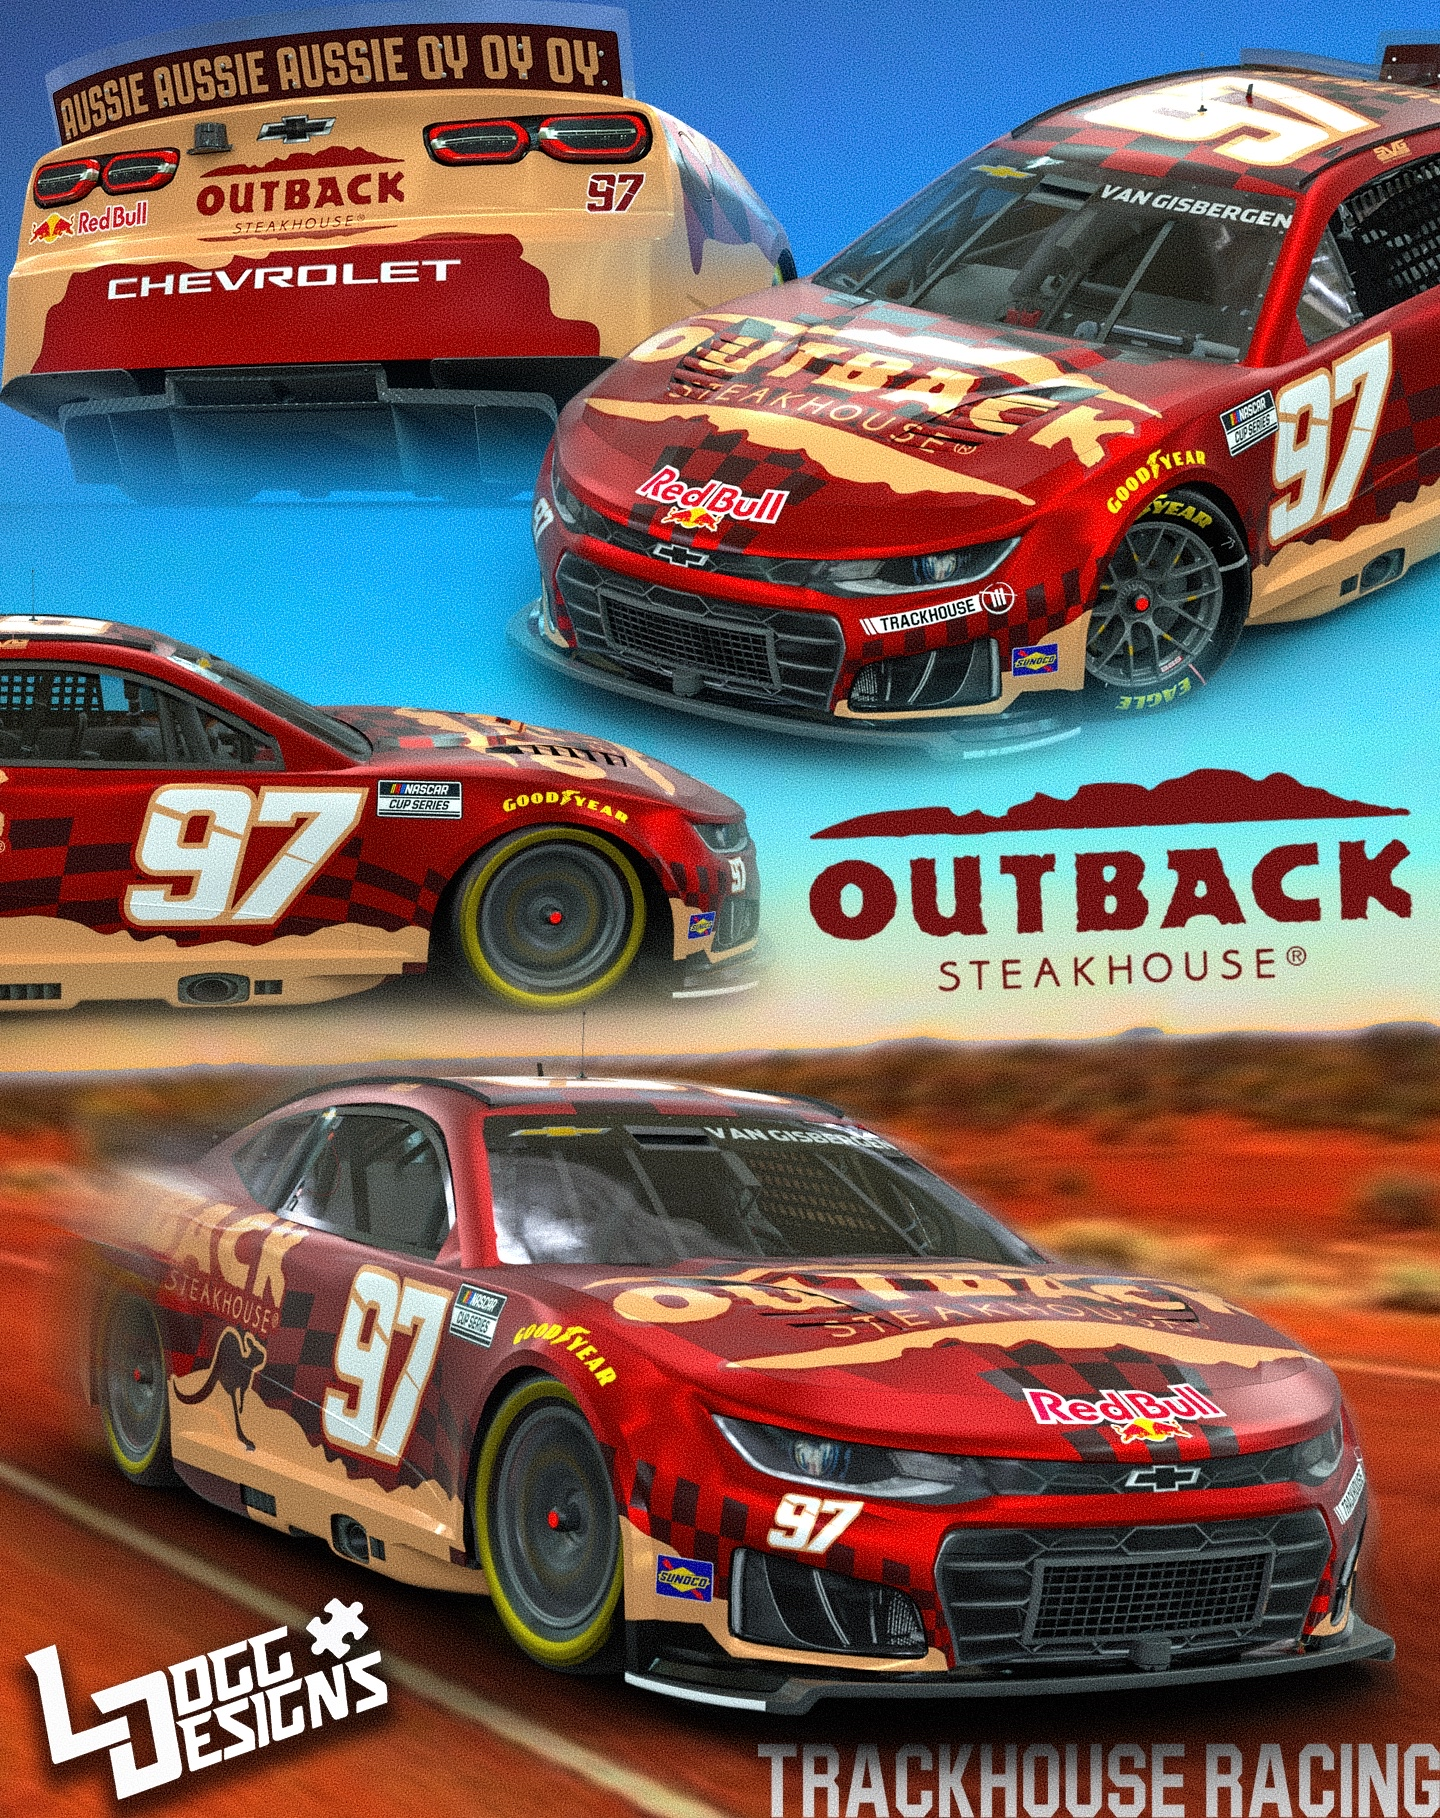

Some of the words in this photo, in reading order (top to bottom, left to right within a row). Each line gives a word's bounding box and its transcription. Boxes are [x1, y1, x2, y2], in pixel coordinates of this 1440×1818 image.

[61, 72, 150, 140] AUSSIE
[153, 50, 269, 109] AUSSIE
[276, 37, 408, 91] AUSSIE
[417, 35, 468, 80] OY
[480, 34, 533, 80] OY
[546, 37, 600, 86] OY
[196, 171, 405, 216] OUTBACK
[586, 172, 646, 214] 97
[1100, 184, 1155, 206] VAN
[1150, 190, 1294, 229] GISBERGEN
[78, 205, 110, 235] Red
[113, 200, 149, 229] Bull
[107, 259, 461, 300] CHEVROLET
[629, 327, 1135, 467] OUTBACK
[1238, 397, 1266, 421] NASCAR
[1234, 426, 1248, 443] CUP
[1248, 414, 1270, 436] SERIES
[1268, 331, 1392, 547] 97
[636, 465, 712, 508] Red
[707, 481, 791, 524] Bull
[880, 598, 976, 632] TRACKHOUSE
[1016, 655, 1055, 669] SUNOCO
[1115, 677, 1193, 710] EAGLE
[388, 799, 411, 810] CUP
[411, 799, 450, 811] SERIES
[404, 783, 449, 796] NASCAR
[124, 783, 369, 926] 97
[704, 1126, 770, 1142] VAN
[469, 1291, 499, 1313] NASCAR
[456, 1311, 470, 1329] CUP
[469, 1315, 491, 1334] SERIES
[322, 1264, 454, 1466] 97
[1022, 1388, 1141, 1424] Red
[1118, 1383, 1227, 1421] Bull
[767, 1493, 865, 1554] 97
[659, 1571, 708, 1588] SUNOCO
